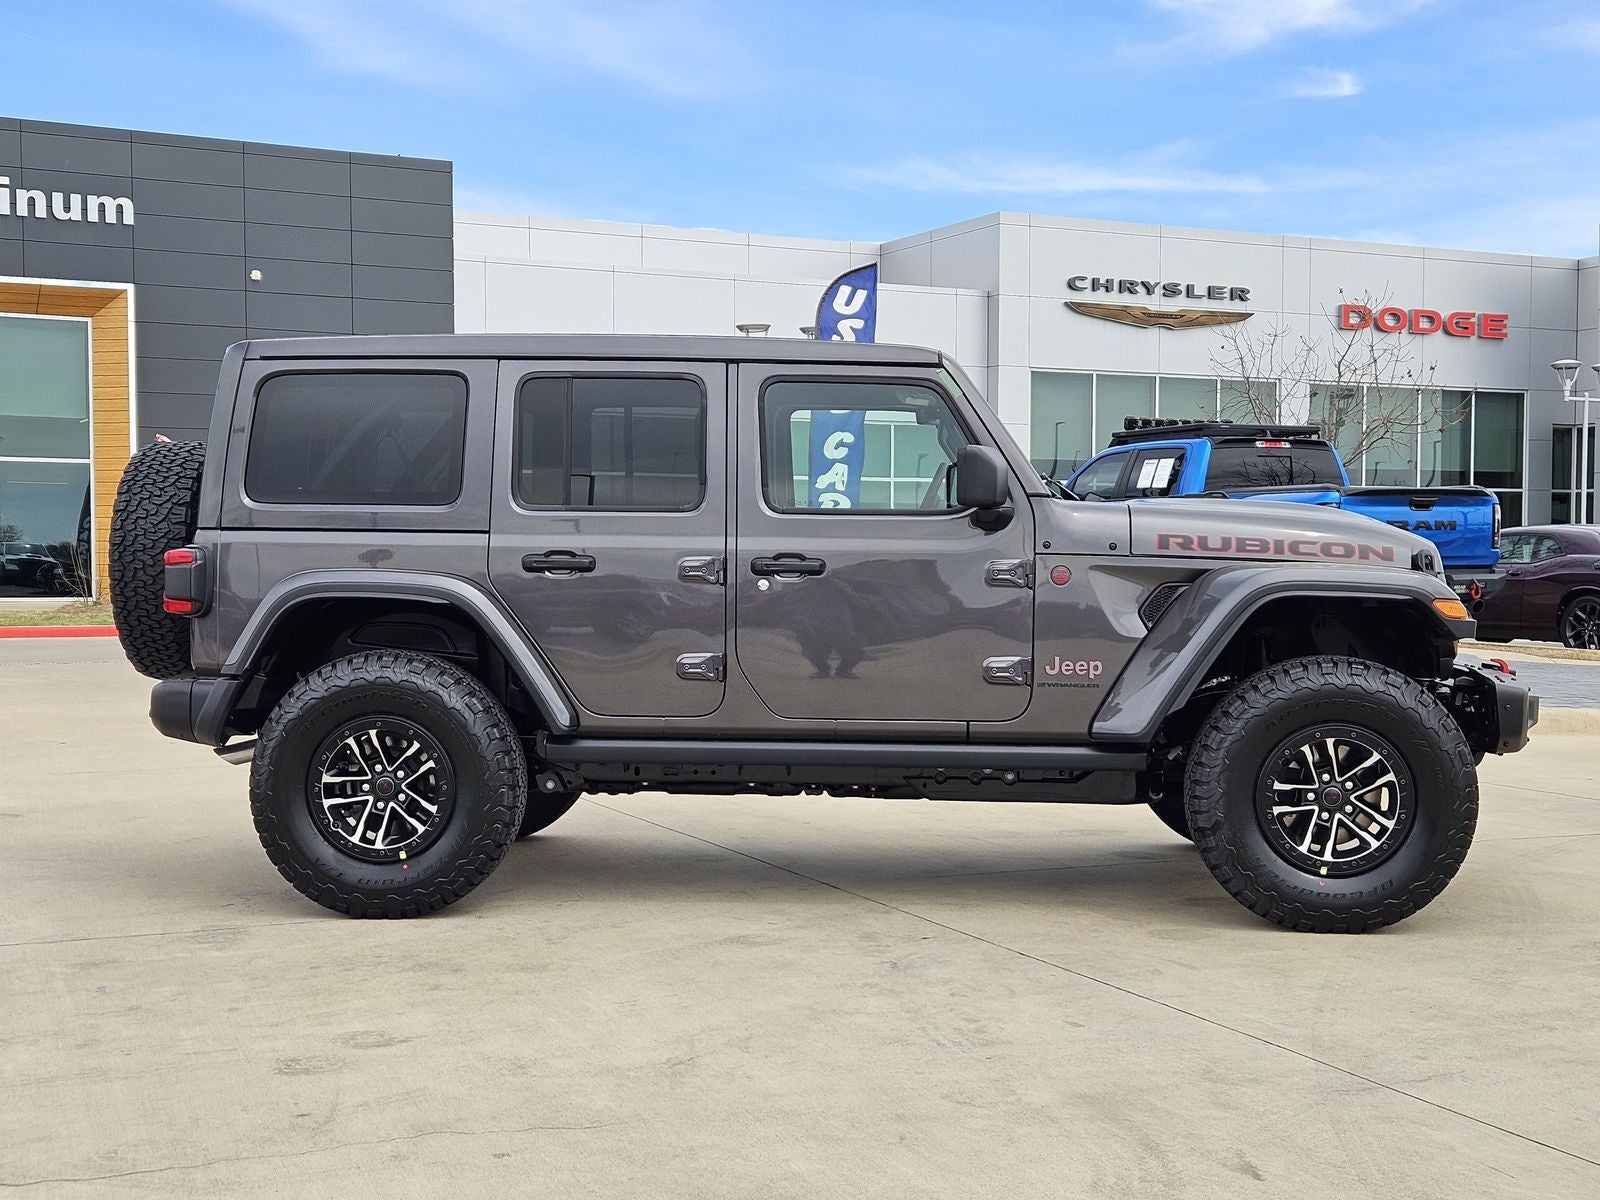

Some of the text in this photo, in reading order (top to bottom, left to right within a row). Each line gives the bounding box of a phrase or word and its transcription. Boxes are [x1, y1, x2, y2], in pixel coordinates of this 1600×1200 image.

[1066, 275, 1251, 302] CHRYSLER
[832, 284, 868, 342] US
[1338, 303, 1508, 340] DODGE
[1156, 532, 1396, 563] RUBICON
[1044, 656, 1103, 680] Jeep
